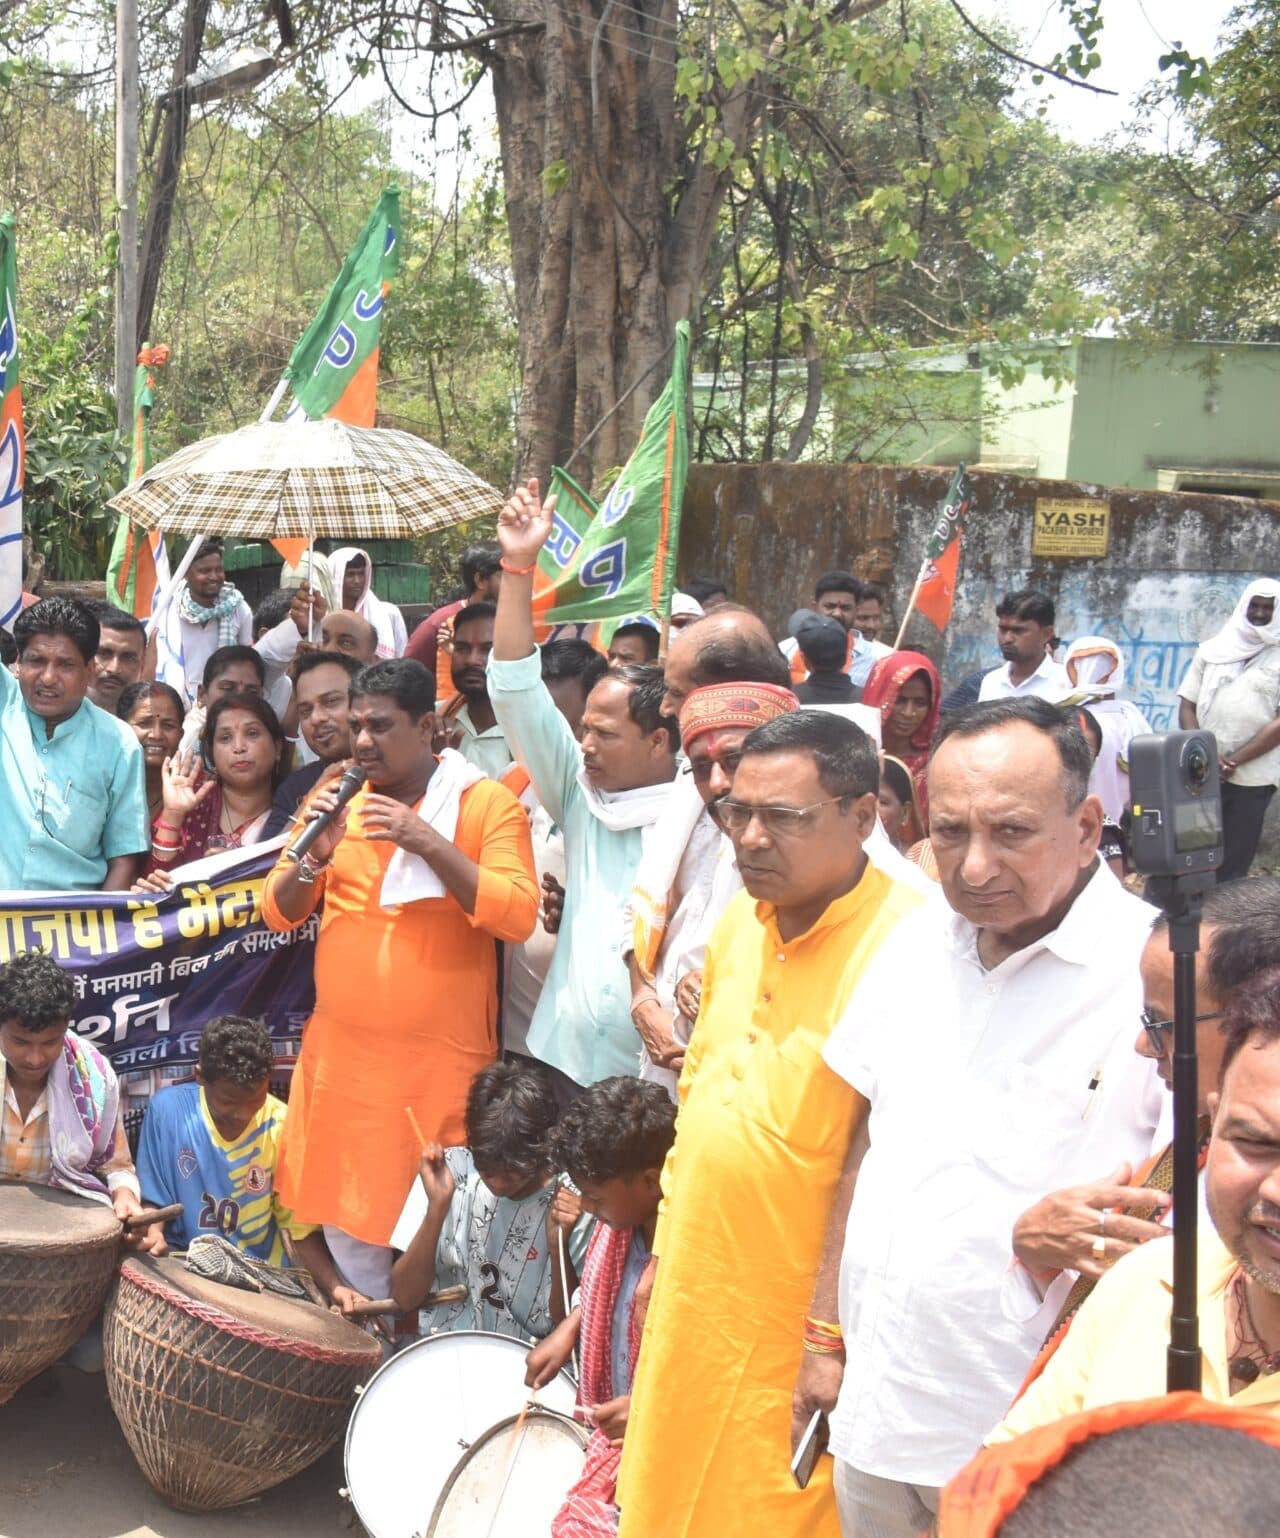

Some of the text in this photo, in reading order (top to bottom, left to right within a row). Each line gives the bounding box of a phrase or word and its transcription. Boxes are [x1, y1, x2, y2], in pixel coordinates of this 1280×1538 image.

[1041, 511, 1106, 527] YASH
[177, 882, 265, 938] मैदा
[91, 961, 165, 996] मनमानी
[169, 955, 212, 982] बिल
[198, 1191, 241, 1237] 20
